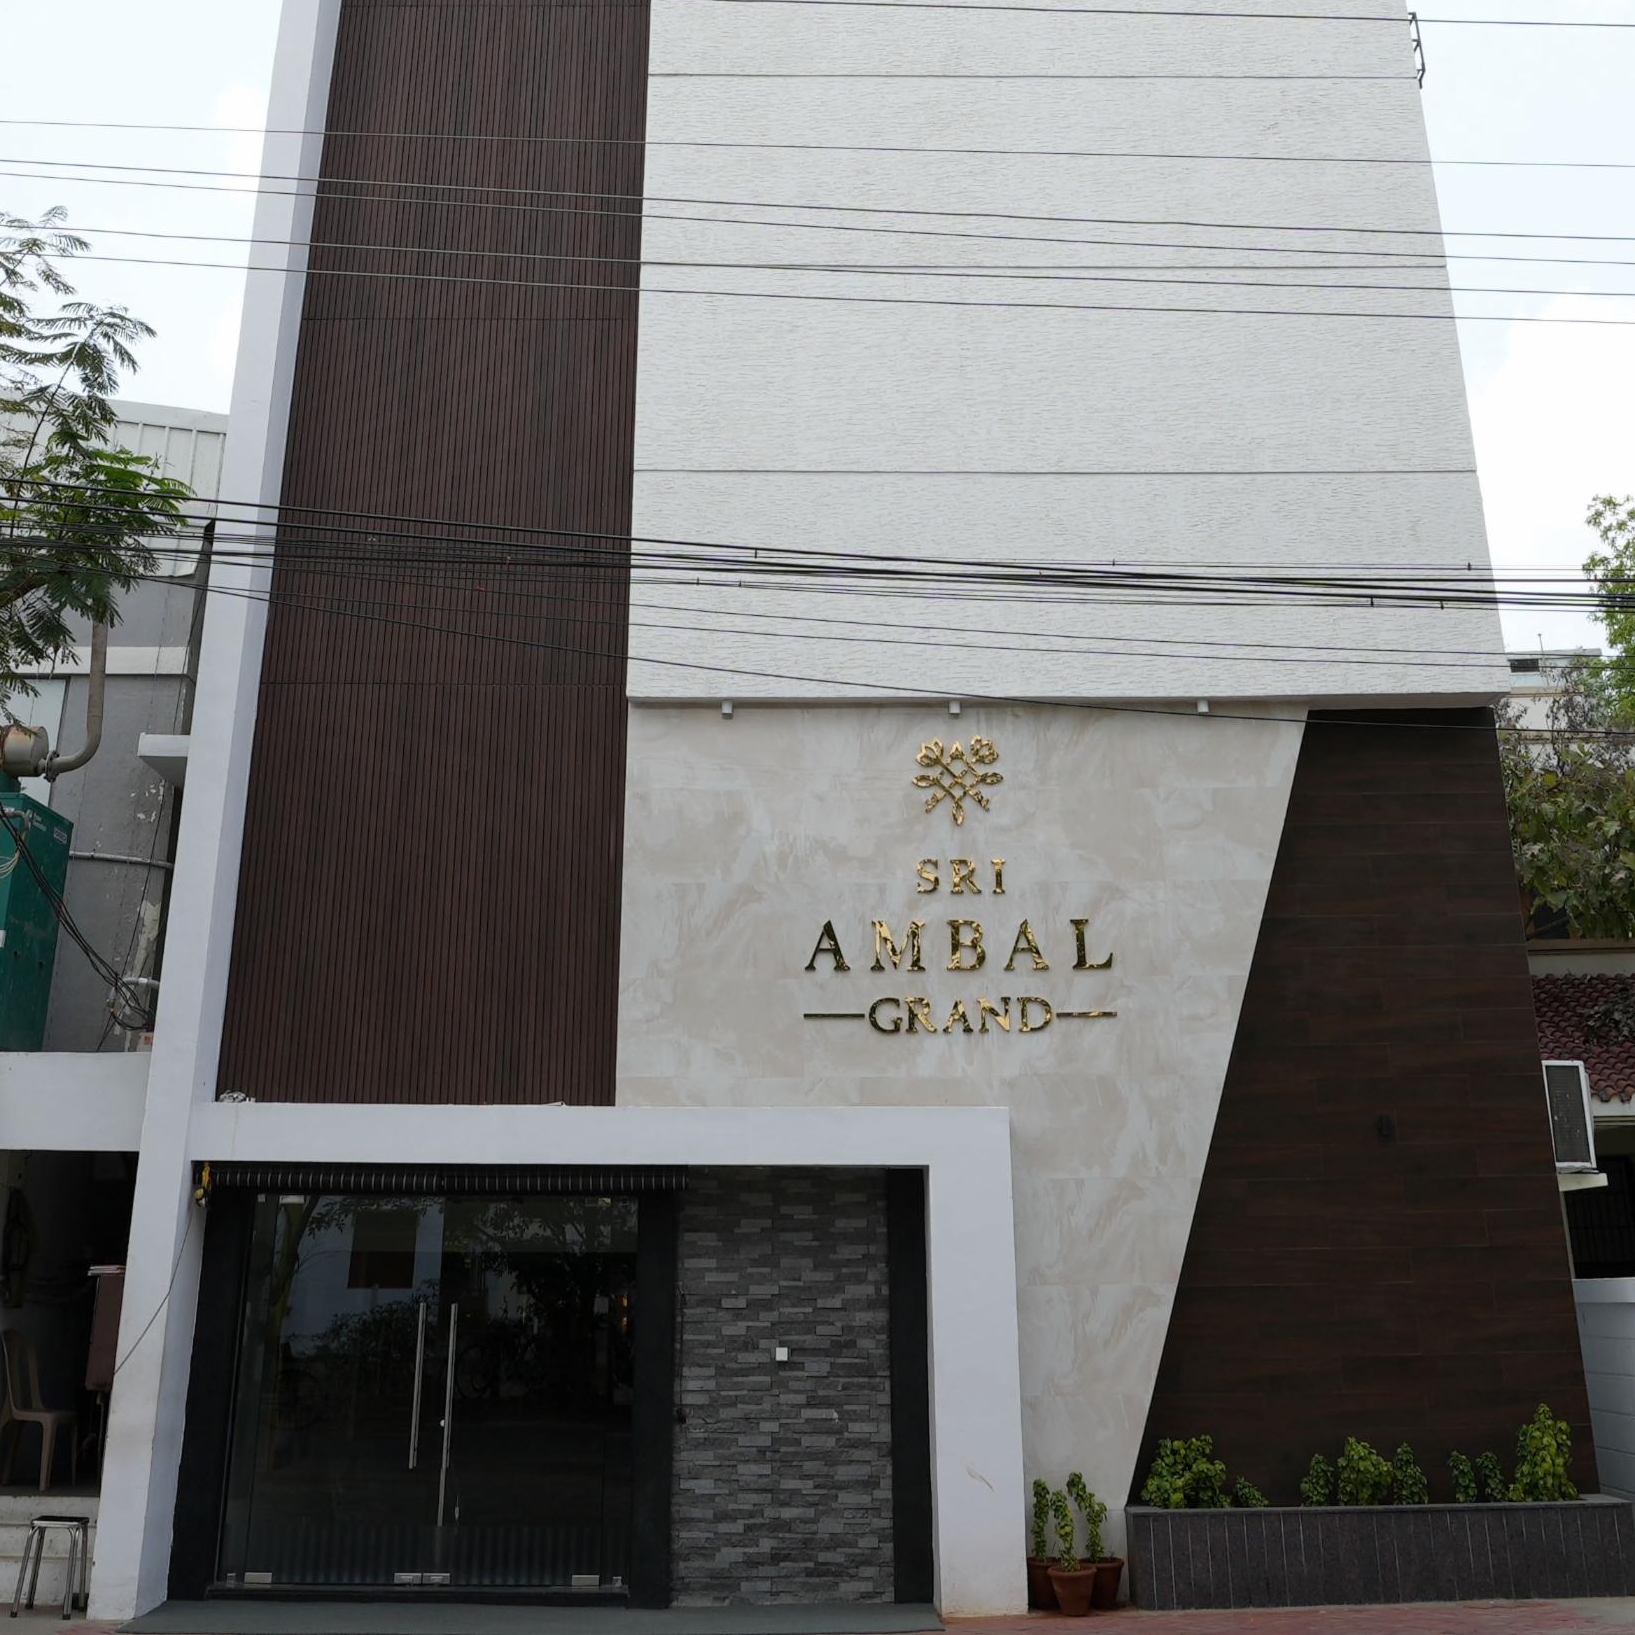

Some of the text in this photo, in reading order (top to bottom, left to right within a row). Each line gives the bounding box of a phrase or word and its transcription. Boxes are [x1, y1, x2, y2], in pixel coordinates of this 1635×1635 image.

[916, 858, 1007, 895] SRI
[804, 918, 1114, 972] AMBAL
[868, 996, 1053, 1034] GRAND
